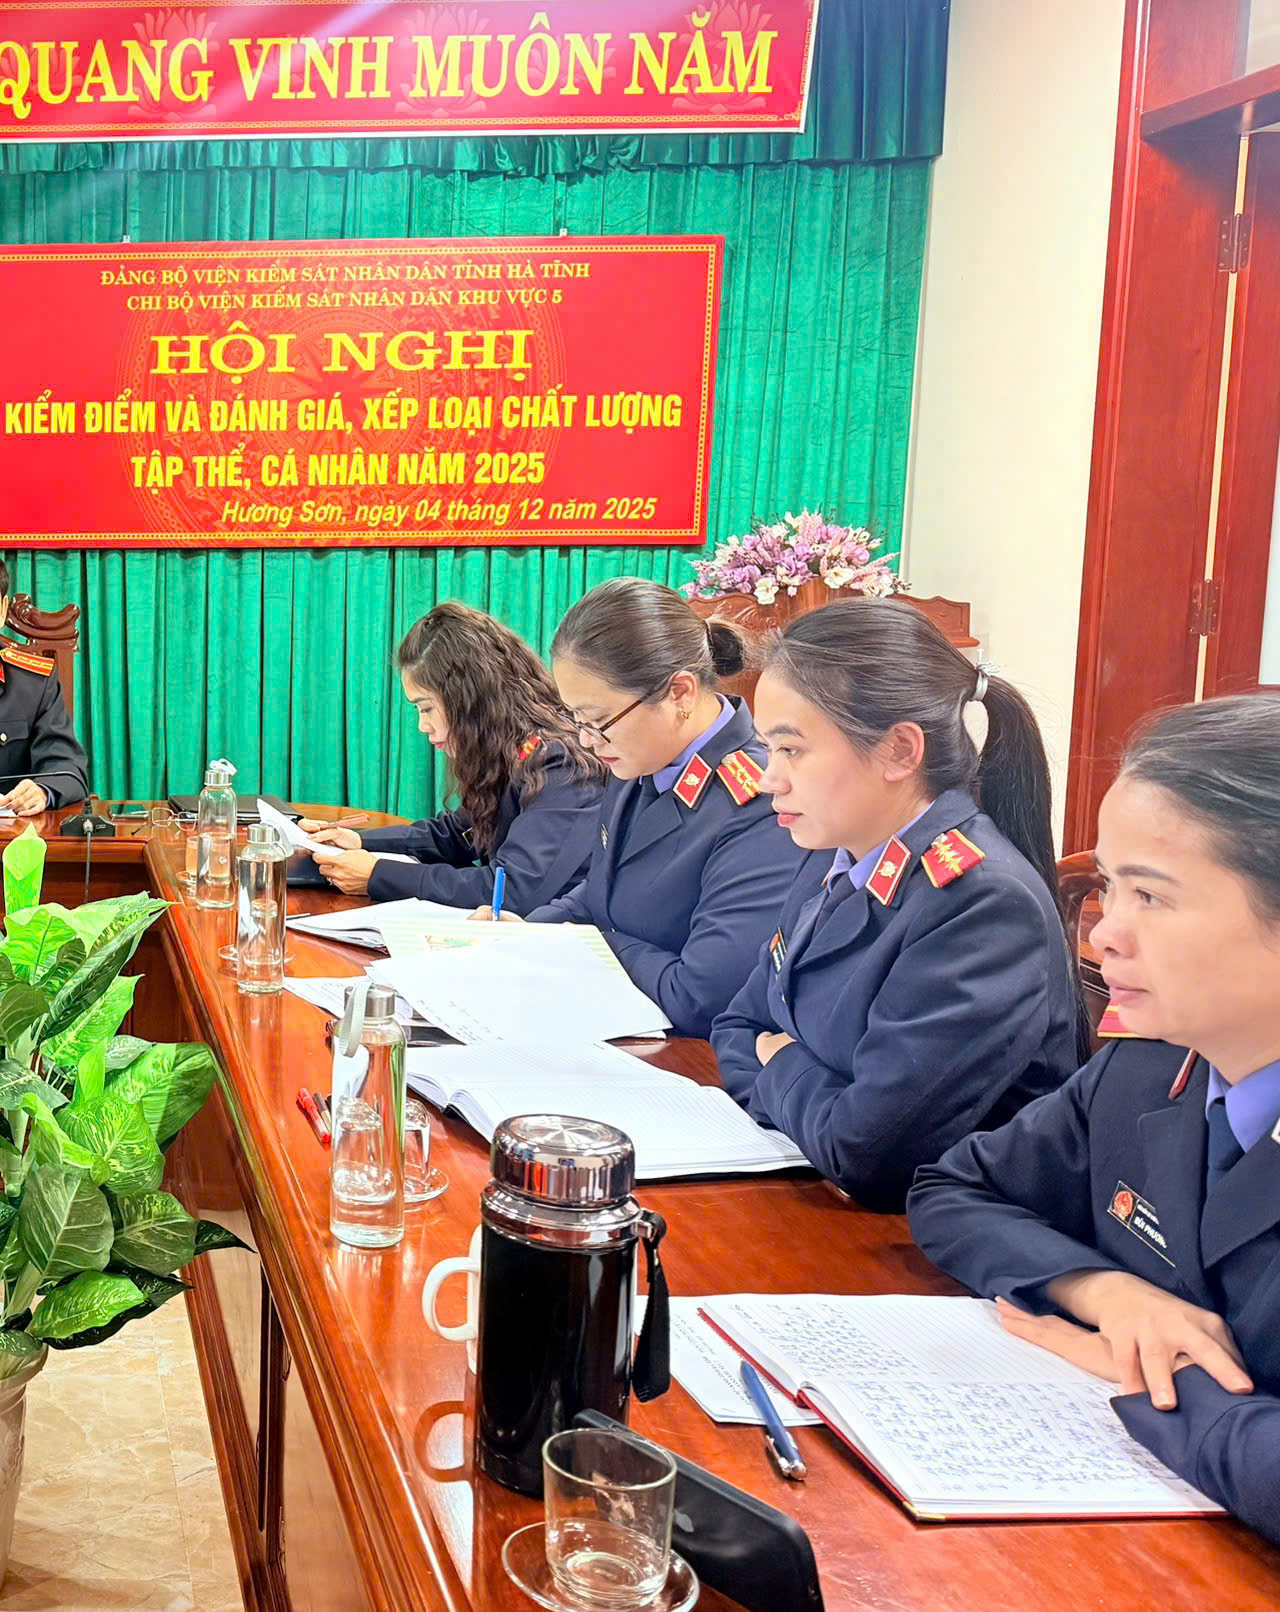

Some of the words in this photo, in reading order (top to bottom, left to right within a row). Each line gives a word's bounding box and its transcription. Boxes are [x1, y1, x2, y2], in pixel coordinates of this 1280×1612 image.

[234, 33, 394, 101] VINH
[409, 12, 611, 98] MUÔN
[624, 10, 778, 96] NĂM
[101, 265, 155, 285] ĐẢNG
[161, 265, 188, 288] BỘ
[193, 265, 240, 287] VIỆN
[246, 260, 296, 283] KIỂM
[301, 264, 338, 282] SÁT
[344, 262, 400, 281] NHÂN
[406, 262, 446, 280] DÂN
[452, 259, 501, 279] TỈNH
[508, 260, 534, 278] HÀ
[540, 260, 590, 278] TĨNH
[127, 296, 160, 311] CHI
[167, 292, 193, 312] BỘ
[199, 291, 245, 312] VIỆN
[251, 286, 301, 309] KIỂM
[307, 289, 344, 307] SÁT
[349, 288, 405, 307] NHÂN
[410, 287, 452, 306] DÂN
[457, 290, 501, 305] KHU
[506, 288, 547, 307] VỰC
[552, 290, 562, 303] 5
[150, 320, 296, 384] HỘI
[322, 328, 534, 381] NGHỊ
[5, 389, 75, 434] KIỂM
[84, 388, 155, 433] ĐIỂM
[165, 393, 200, 432] VÀ
[210, 393, 288, 432] ĐÁNH
[297, 391, 352, 434] GIÁ,
[362, 387, 419, 430] XẾP
[428, 395, 492, 436] LOẠI
[502, 384, 577, 428] CHẤT
[585, 391, 682, 434] LƯỢNG
[131, 450, 183, 494] TẬP
[192, 442, 251, 490] THỂ,
[261, 448, 298, 487] CÁ
[308, 447, 388, 486] NHÂN
[397, 446, 465, 485] NĂM
[474, 452, 545, 484] 2025
[222, 500, 292, 527] Hương
[299, 500, 348, 525] Sơn,
[354, 501, 409, 527] ngày
[414, 500, 440, 520] 04
[447, 499, 510, 526] tháng
[520, 498, 544, 520] 12
[548, 498, 596, 520] năm
[602, 497, 657, 520] 2025
